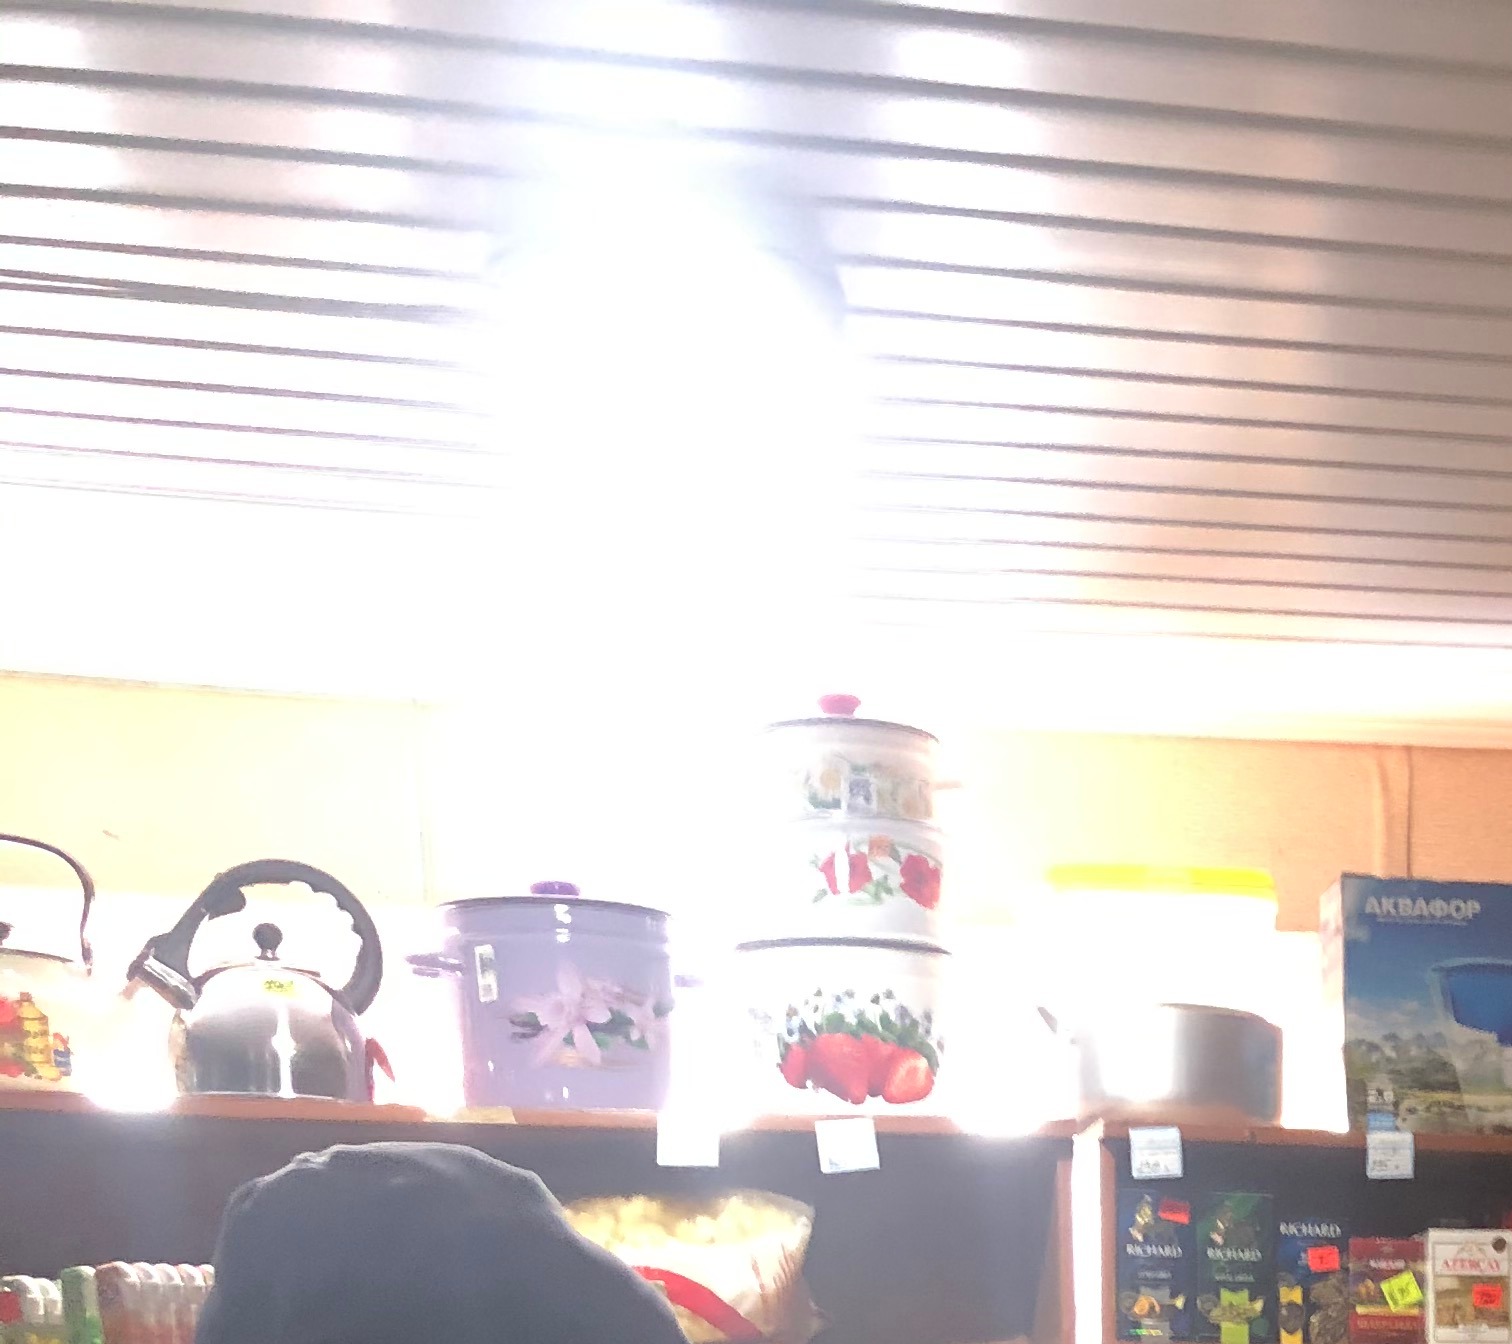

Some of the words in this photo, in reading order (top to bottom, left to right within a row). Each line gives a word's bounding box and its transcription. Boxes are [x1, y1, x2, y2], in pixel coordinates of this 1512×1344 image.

[1365, 896, 1481, 920] АКВАФОР
[1279, 1221, 1342, 1238] RICHARD
[1126, 1243, 1183, 1259] RICHARD
[1207, 1246, 1263, 1261] RICHARD
